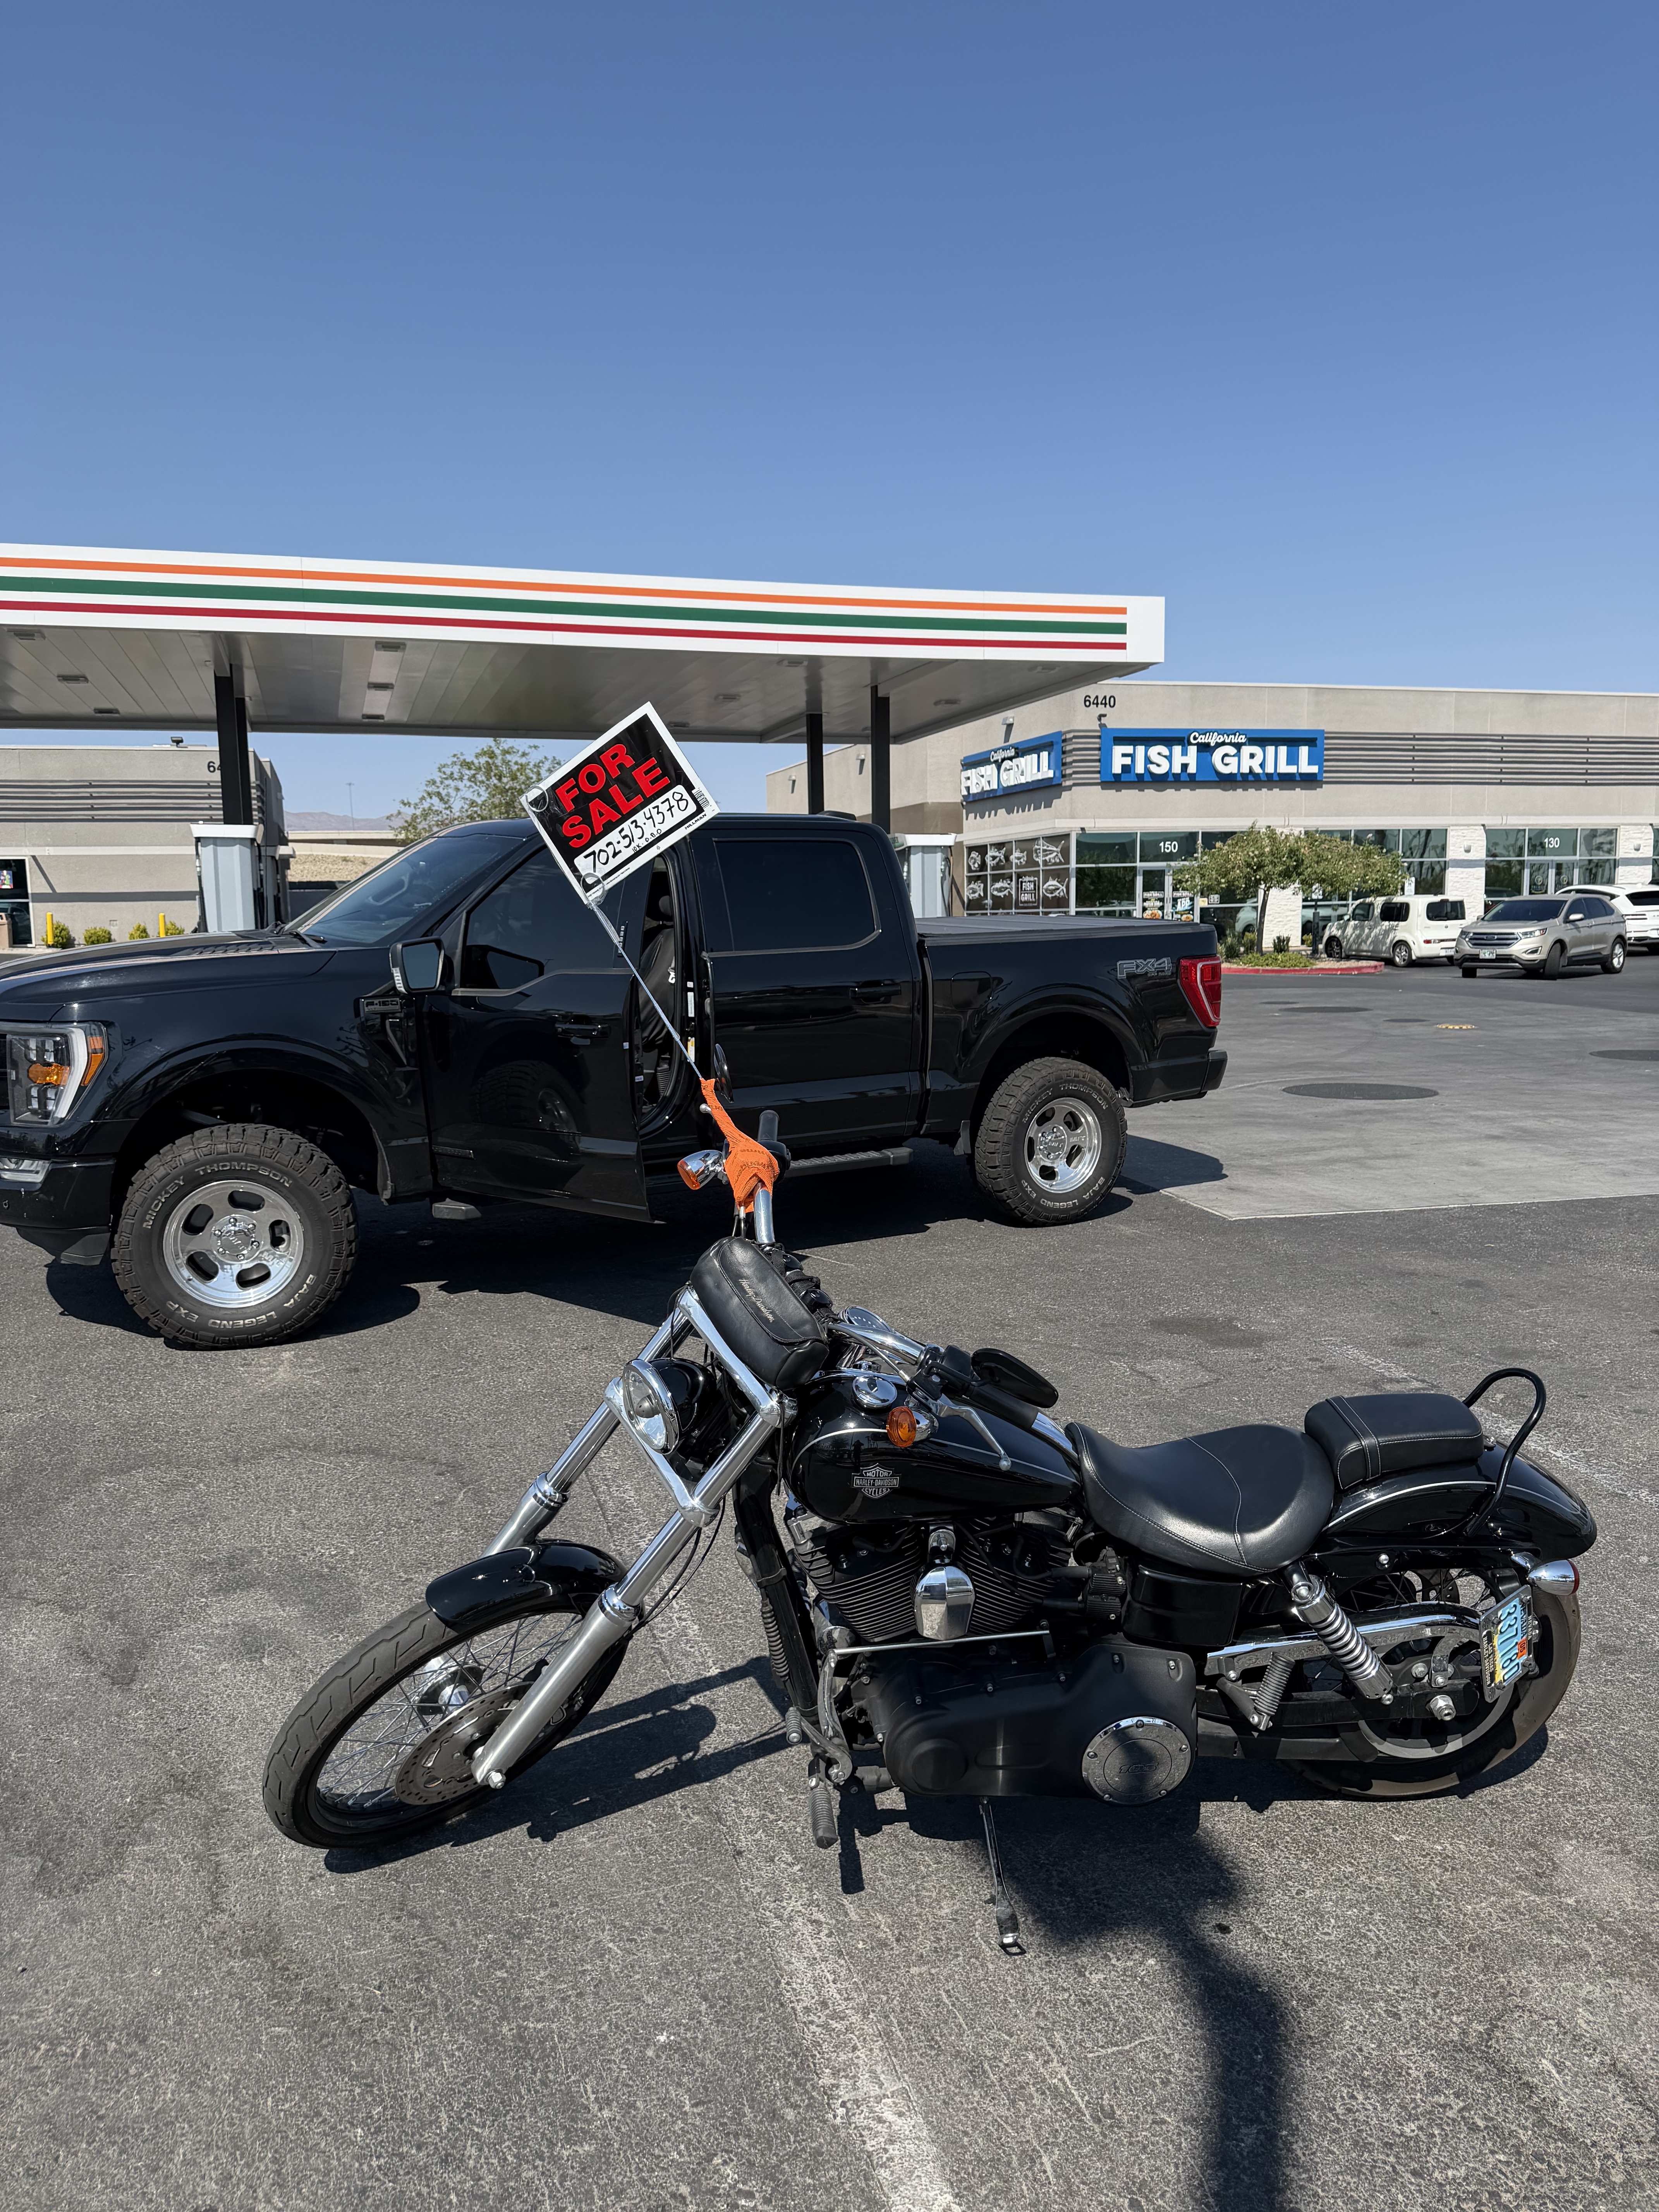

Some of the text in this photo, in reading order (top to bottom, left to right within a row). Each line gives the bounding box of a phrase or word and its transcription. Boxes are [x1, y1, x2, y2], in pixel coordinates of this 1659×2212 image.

[1084, 695, 1116, 708] 6440
[1190, 732, 1247, 746] California
[990, 747, 1015, 762] California
[1112, 745, 1319, 774] FISH GRILL
[555, 744, 635, 812] FOR
[961, 751, 1054, 795] FISH GRILL
[562, 757, 670, 847] SALE
[1159, 841, 1178, 853] 150
[1544, 837, 1560, 848] 130
[1022, 882, 1034, 891] FISH
[1021, 893, 1036, 902] GRILL
[1176, 900, 1190, 911] APP
[1117, 957, 1172, 979] FX4
[1022, 1083, 1108, 1123] MICKEY THOMPSON
[143, 1162, 293, 1229] MICKEY THOMPSON
[1021, 1176, 1105, 1209] BAJA LEGEND EXP
[166, 1274, 317, 1329] BAJA LEGEND EXP
[866, 1469, 888, 1477] MOTOR
[865, 1488, 887, 1496] CYCLES
[1499, 1602, 1520, 1683] 337180
[1520, 1642, 1526, 1653] 05
